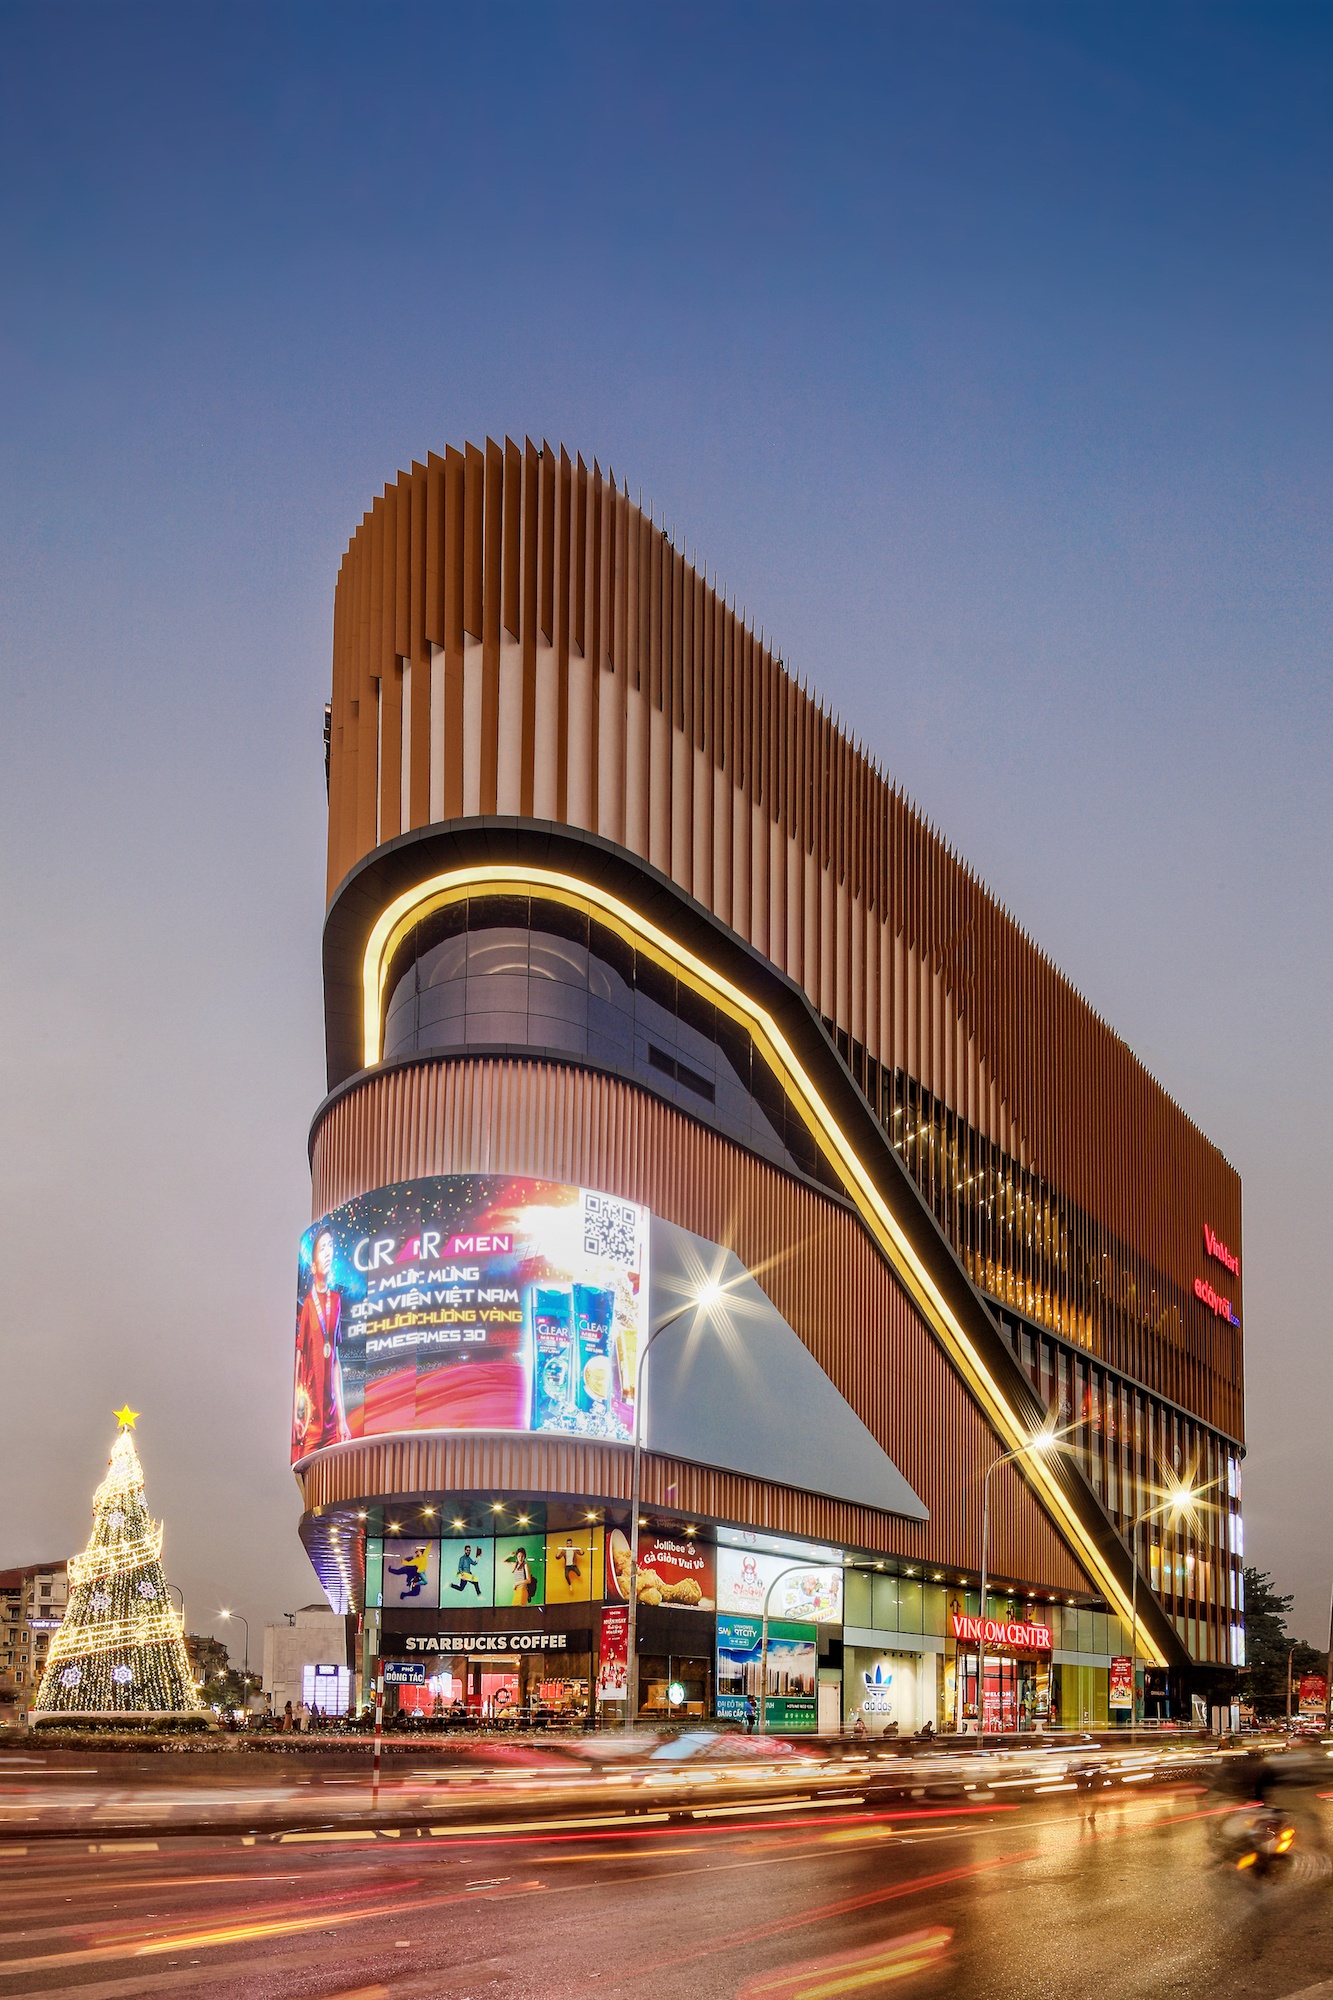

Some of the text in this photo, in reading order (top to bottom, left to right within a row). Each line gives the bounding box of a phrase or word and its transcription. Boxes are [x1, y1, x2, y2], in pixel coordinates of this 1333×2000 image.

[455, 1235, 509, 1254] MEN
[1203, 1223, 1240, 1277] VinMart
[434, 1285, 475, 1308] VIỆT
[477, 1288, 519, 1304] NAM
[478, 1306, 523, 1323] VÀNG
[538, 1324, 568, 1337] CLEAR
[579, 1319, 608, 1334] CLEAR
[581, 1331, 598, 1339] MEN
[654, 1539, 685, 1553] Jollibee
[644, 1551, 656, 1564] Gà
[657, 1552, 677, 1566] Giòn
[678, 1557, 693, 1570] Vui
[953, 1616, 1051, 1647] VINCOM CENTER
[405, 1634, 567, 1650] STARBUCKS COFFEE
[386, 1671, 423, 1682] ĐÔNG TÁC
[864, 1699, 892, 1712] adidas
